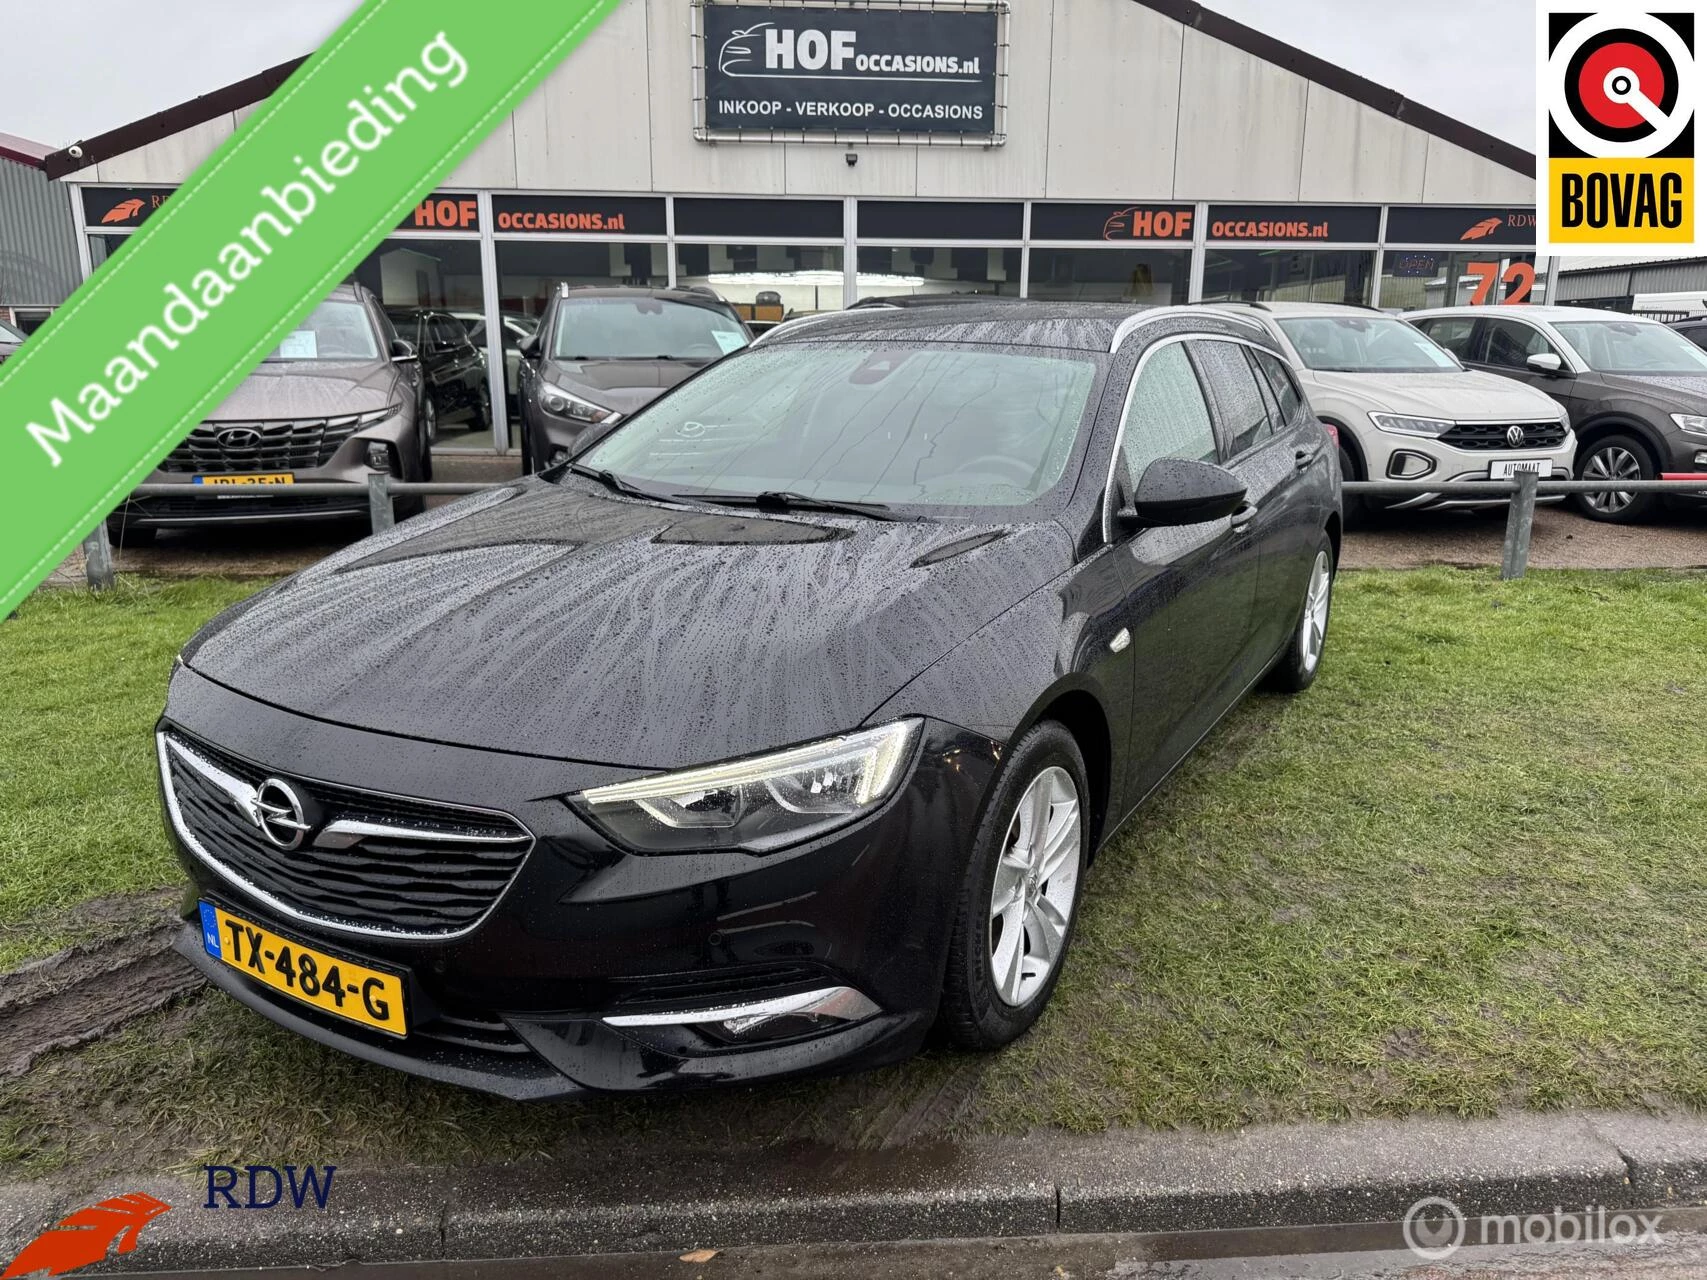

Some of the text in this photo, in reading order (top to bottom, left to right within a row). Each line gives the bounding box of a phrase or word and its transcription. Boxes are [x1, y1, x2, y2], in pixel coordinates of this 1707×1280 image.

[765, 28, 981, 75] HOF OCCASIONS.nl
[718, 100, 782, 115] INKOOP
[795, 101, 875, 117] VERKOOP
[888, 103, 984, 120] OCCASIONS
[415, 200, 625, 230] HOF OCCASIONS.nl
[1132, 211, 1329, 238] HOF OCCASIONS.nl
[1466, 262, 1536, 305] 72
[206, 932, 219, 949] NL
[225, 919, 390, 1021] TX-484-G
